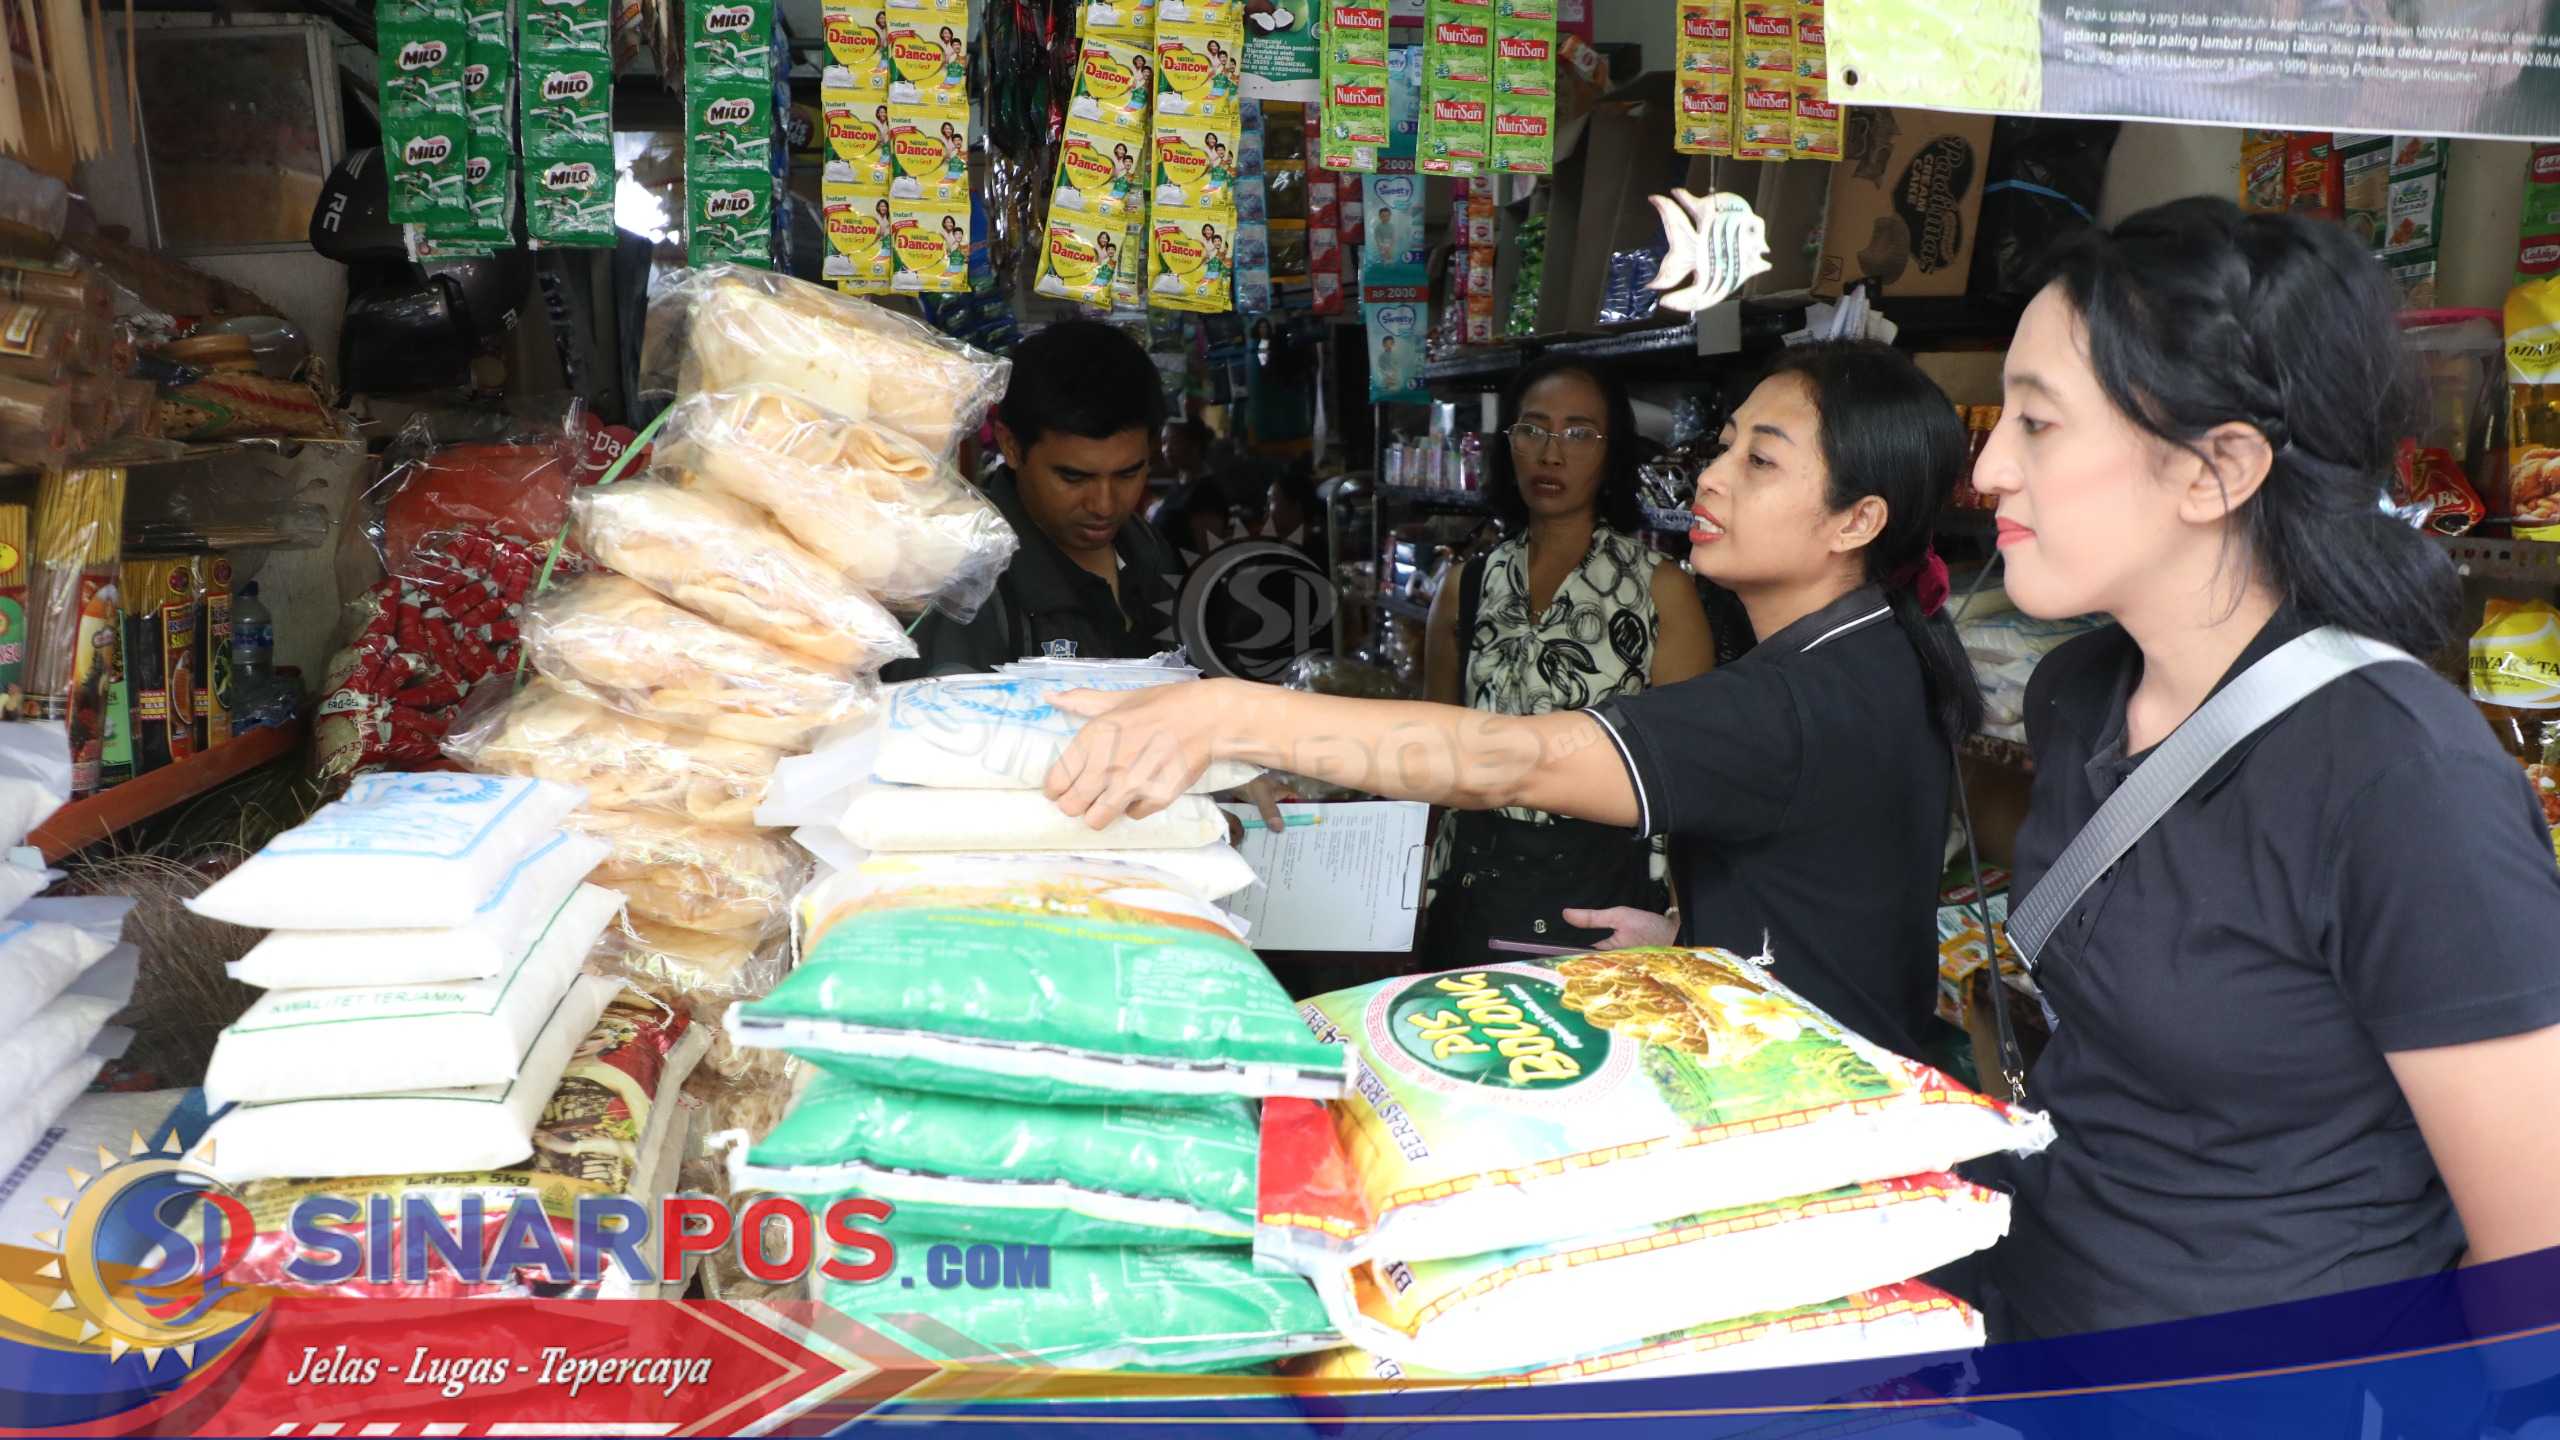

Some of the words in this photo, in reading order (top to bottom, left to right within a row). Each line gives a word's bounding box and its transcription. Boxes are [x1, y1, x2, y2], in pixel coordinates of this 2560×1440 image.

[710, 13, 750, 28] MILO
[1748, 18, 1790, 35] NutriSari
[2065, 6, 2106, 21] Pelaku
[2110, 10, 2145, 24] usaha
[2149, 14, 2178, 28] yang
[2182, 13, 2208, 25] tidak
[2329, 22, 2360, 37] harga
[2416, 25, 2478, 41] MINYAKITA
[829, 29, 876, 45] Dancow
[895, 44, 941, 61] Dancow
[2064, 27, 2107, 44] pidana
[2109, 31, 2156, 47] penjara
[2159, 33, 2198, 50] paling
[2200, 35, 2242, 49] lambat
[2255, 38, 2289, 53] (lima)
[2292, 40, 2328, 53] tahun
[2356, 43, 2395, 58] pidana
[2398, 47, 2432, 60] denda
[2434, 49, 2468, 65] paling
[2471, 51, 2509, 65] banyak
[404, 50, 441, 65] MILO
[1164, 56, 1208, 73] Dancow
[1086, 61, 1131, 85] Dancow
[548, 80, 588, 95] MILO
[710, 107, 749, 120] MILO
[830, 124, 877, 140] Dancow
[409, 145, 447, 160] MILO
[896, 141, 942, 156] Dancow
[1067, 152, 1112, 174] Dancow
[1163, 149, 1206, 166] Dancow
[550, 170, 590, 186] MILO
[711, 198, 749, 213] MILO
[830, 219, 877, 234] Dancow
[897, 235, 943, 250] Dancow
[1161, 240, 1201, 257] Dancow
[1052, 241, 1094, 262] Dancow
[489, 1171, 531, 1187] 5kg
